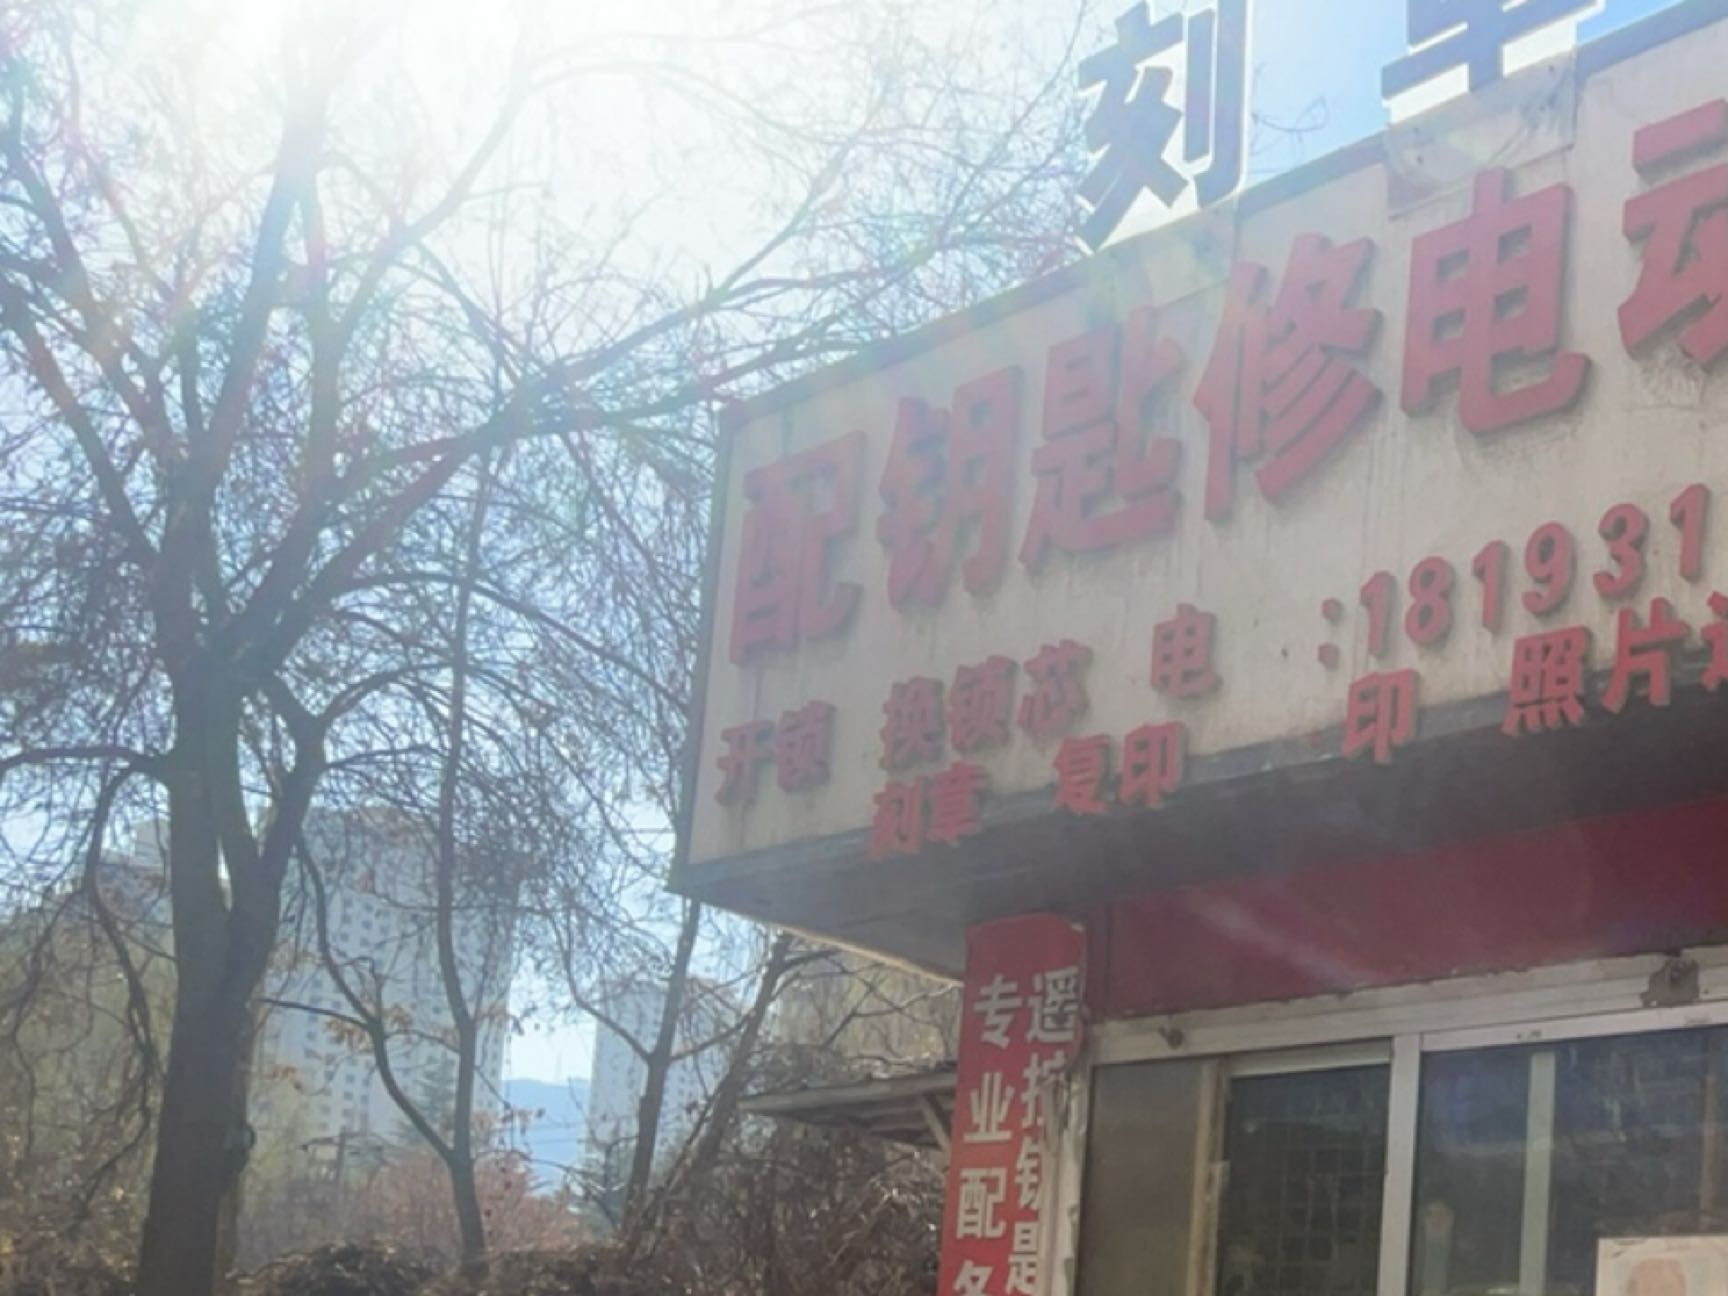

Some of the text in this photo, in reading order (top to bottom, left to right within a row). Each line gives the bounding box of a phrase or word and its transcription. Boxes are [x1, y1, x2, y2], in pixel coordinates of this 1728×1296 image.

[714, 701, 832, 805] 开锁
[880, 639, 1091, 773] 换锁芯
[1150, 603, 1222, 698] 电
[870, 761, 987, 862] 刻章
[1054, 721, 1188, 815] 复印
[1341, 668, 1419, 765] 印
